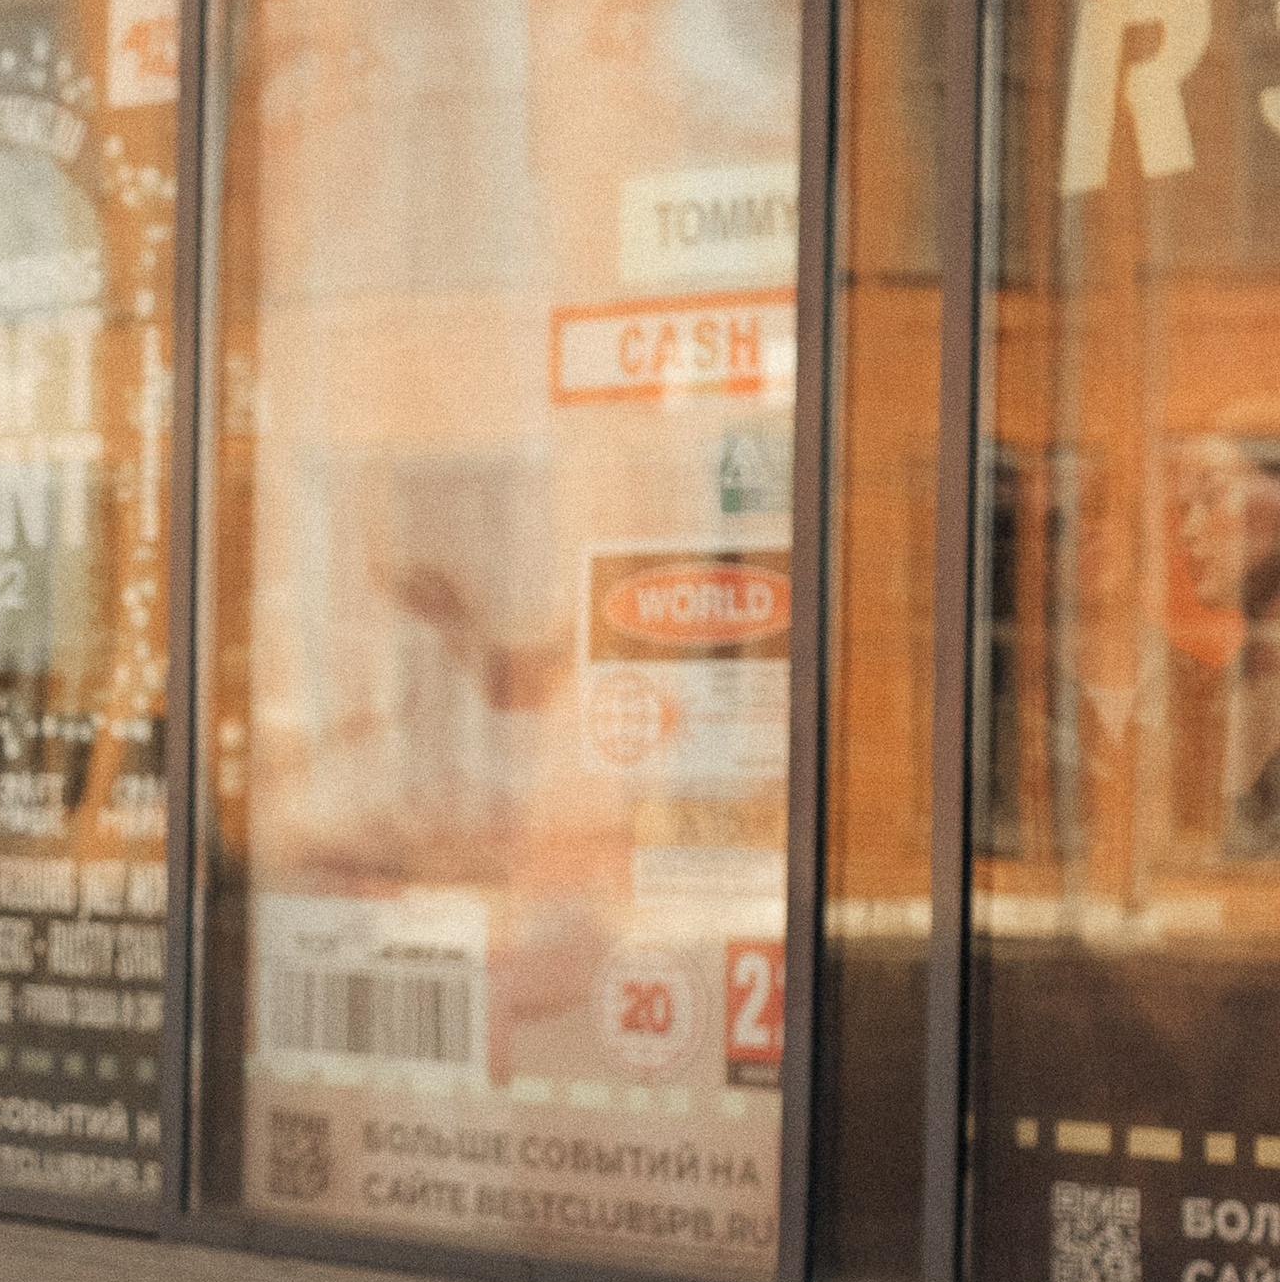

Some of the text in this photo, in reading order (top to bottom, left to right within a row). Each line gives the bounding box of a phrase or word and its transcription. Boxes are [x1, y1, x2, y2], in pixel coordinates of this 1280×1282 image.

[618, 315, 762, 376] CASH
[634, 583, 775, 624] WORLD
[620, 981, 674, 1036] 20
[361, 1119, 763, 1189] БОЛЬШЕ СОБЫТИЙ НА
[361, 1168, 776, 1249] САЙТЕ BESTCLUBSPB.RU
